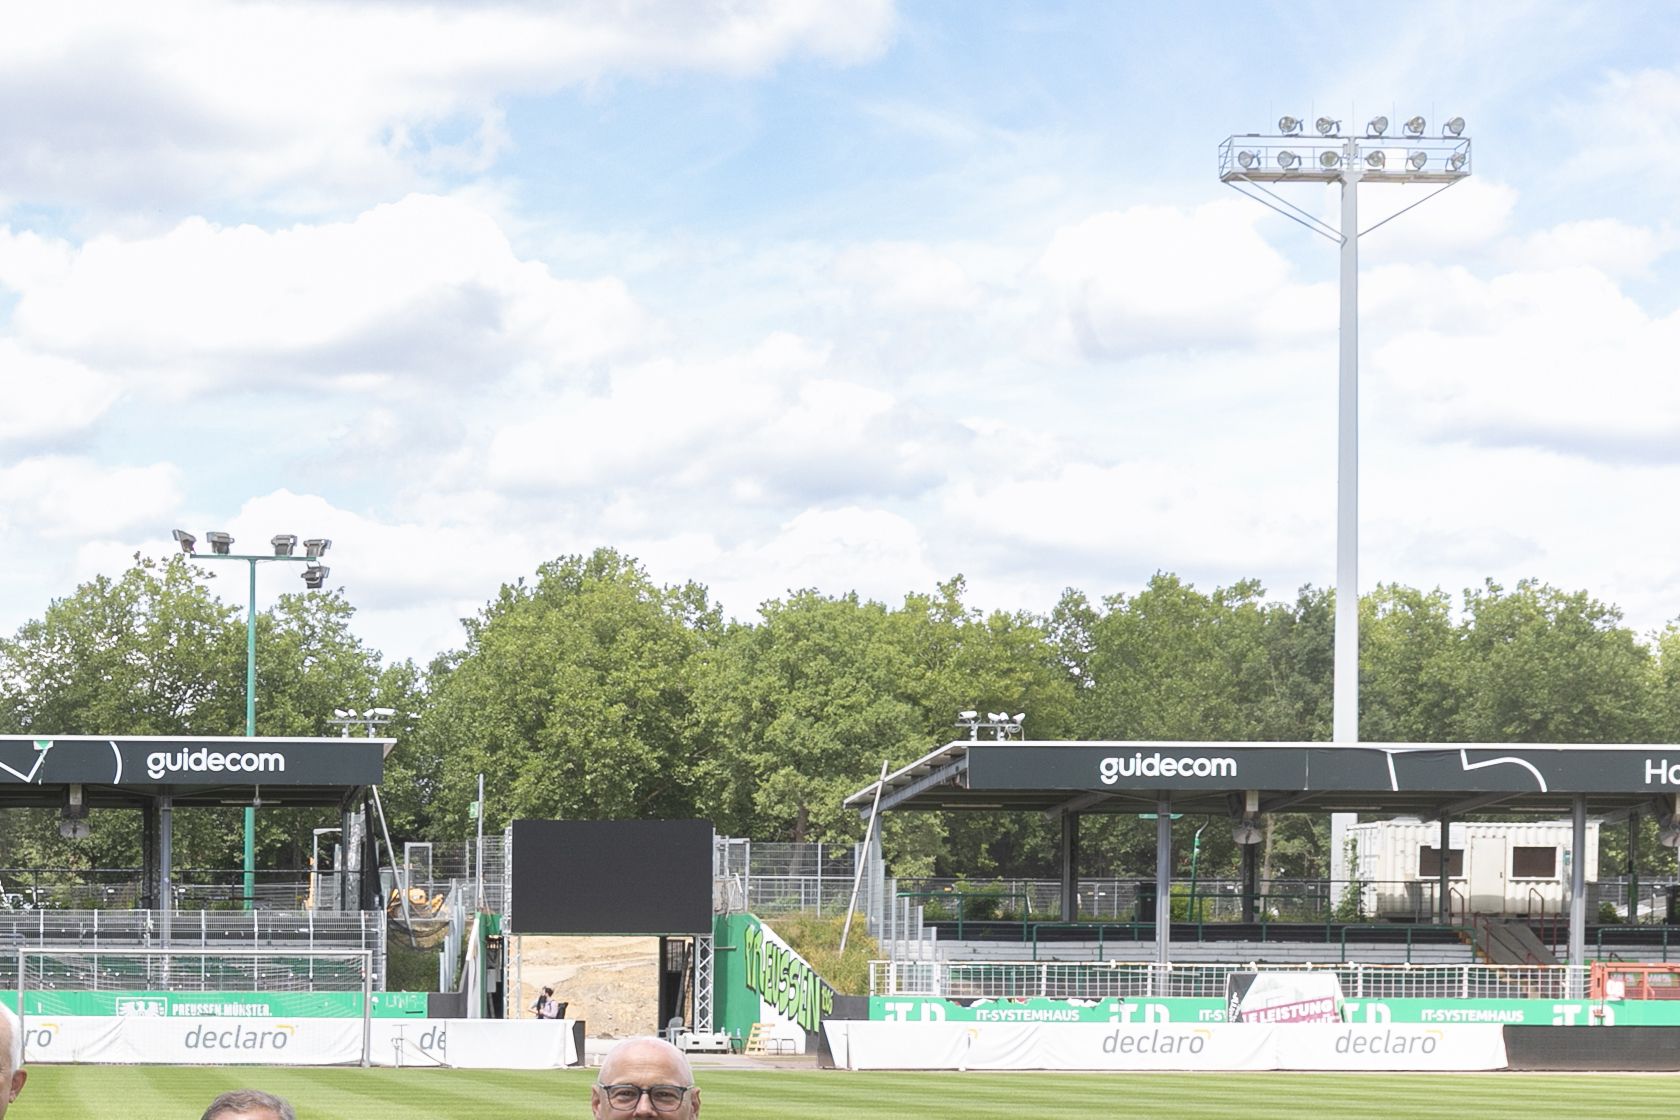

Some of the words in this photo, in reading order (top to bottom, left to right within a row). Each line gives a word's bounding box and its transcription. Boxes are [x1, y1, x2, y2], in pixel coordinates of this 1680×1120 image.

[147, 748, 285, 779] guidecom
[1099, 752, 1237, 784] guidecom
[745, 924, 820, 1034] PREUSSEN
[172, 1003, 221, 1016] PREUSSEN
[976, 1009, 1080, 1021] IT-SYSTEMHAUS
[1260, 1000, 1333, 1023] LEISTUNG
[1422, 1009, 1524, 1022] IT-SYSTEMHAUS
[185, 1025, 288, 1049] declaro
[1103, 1030, 1204, 1054] declaro
[1335, 1030, 1436, 1054] declaro
